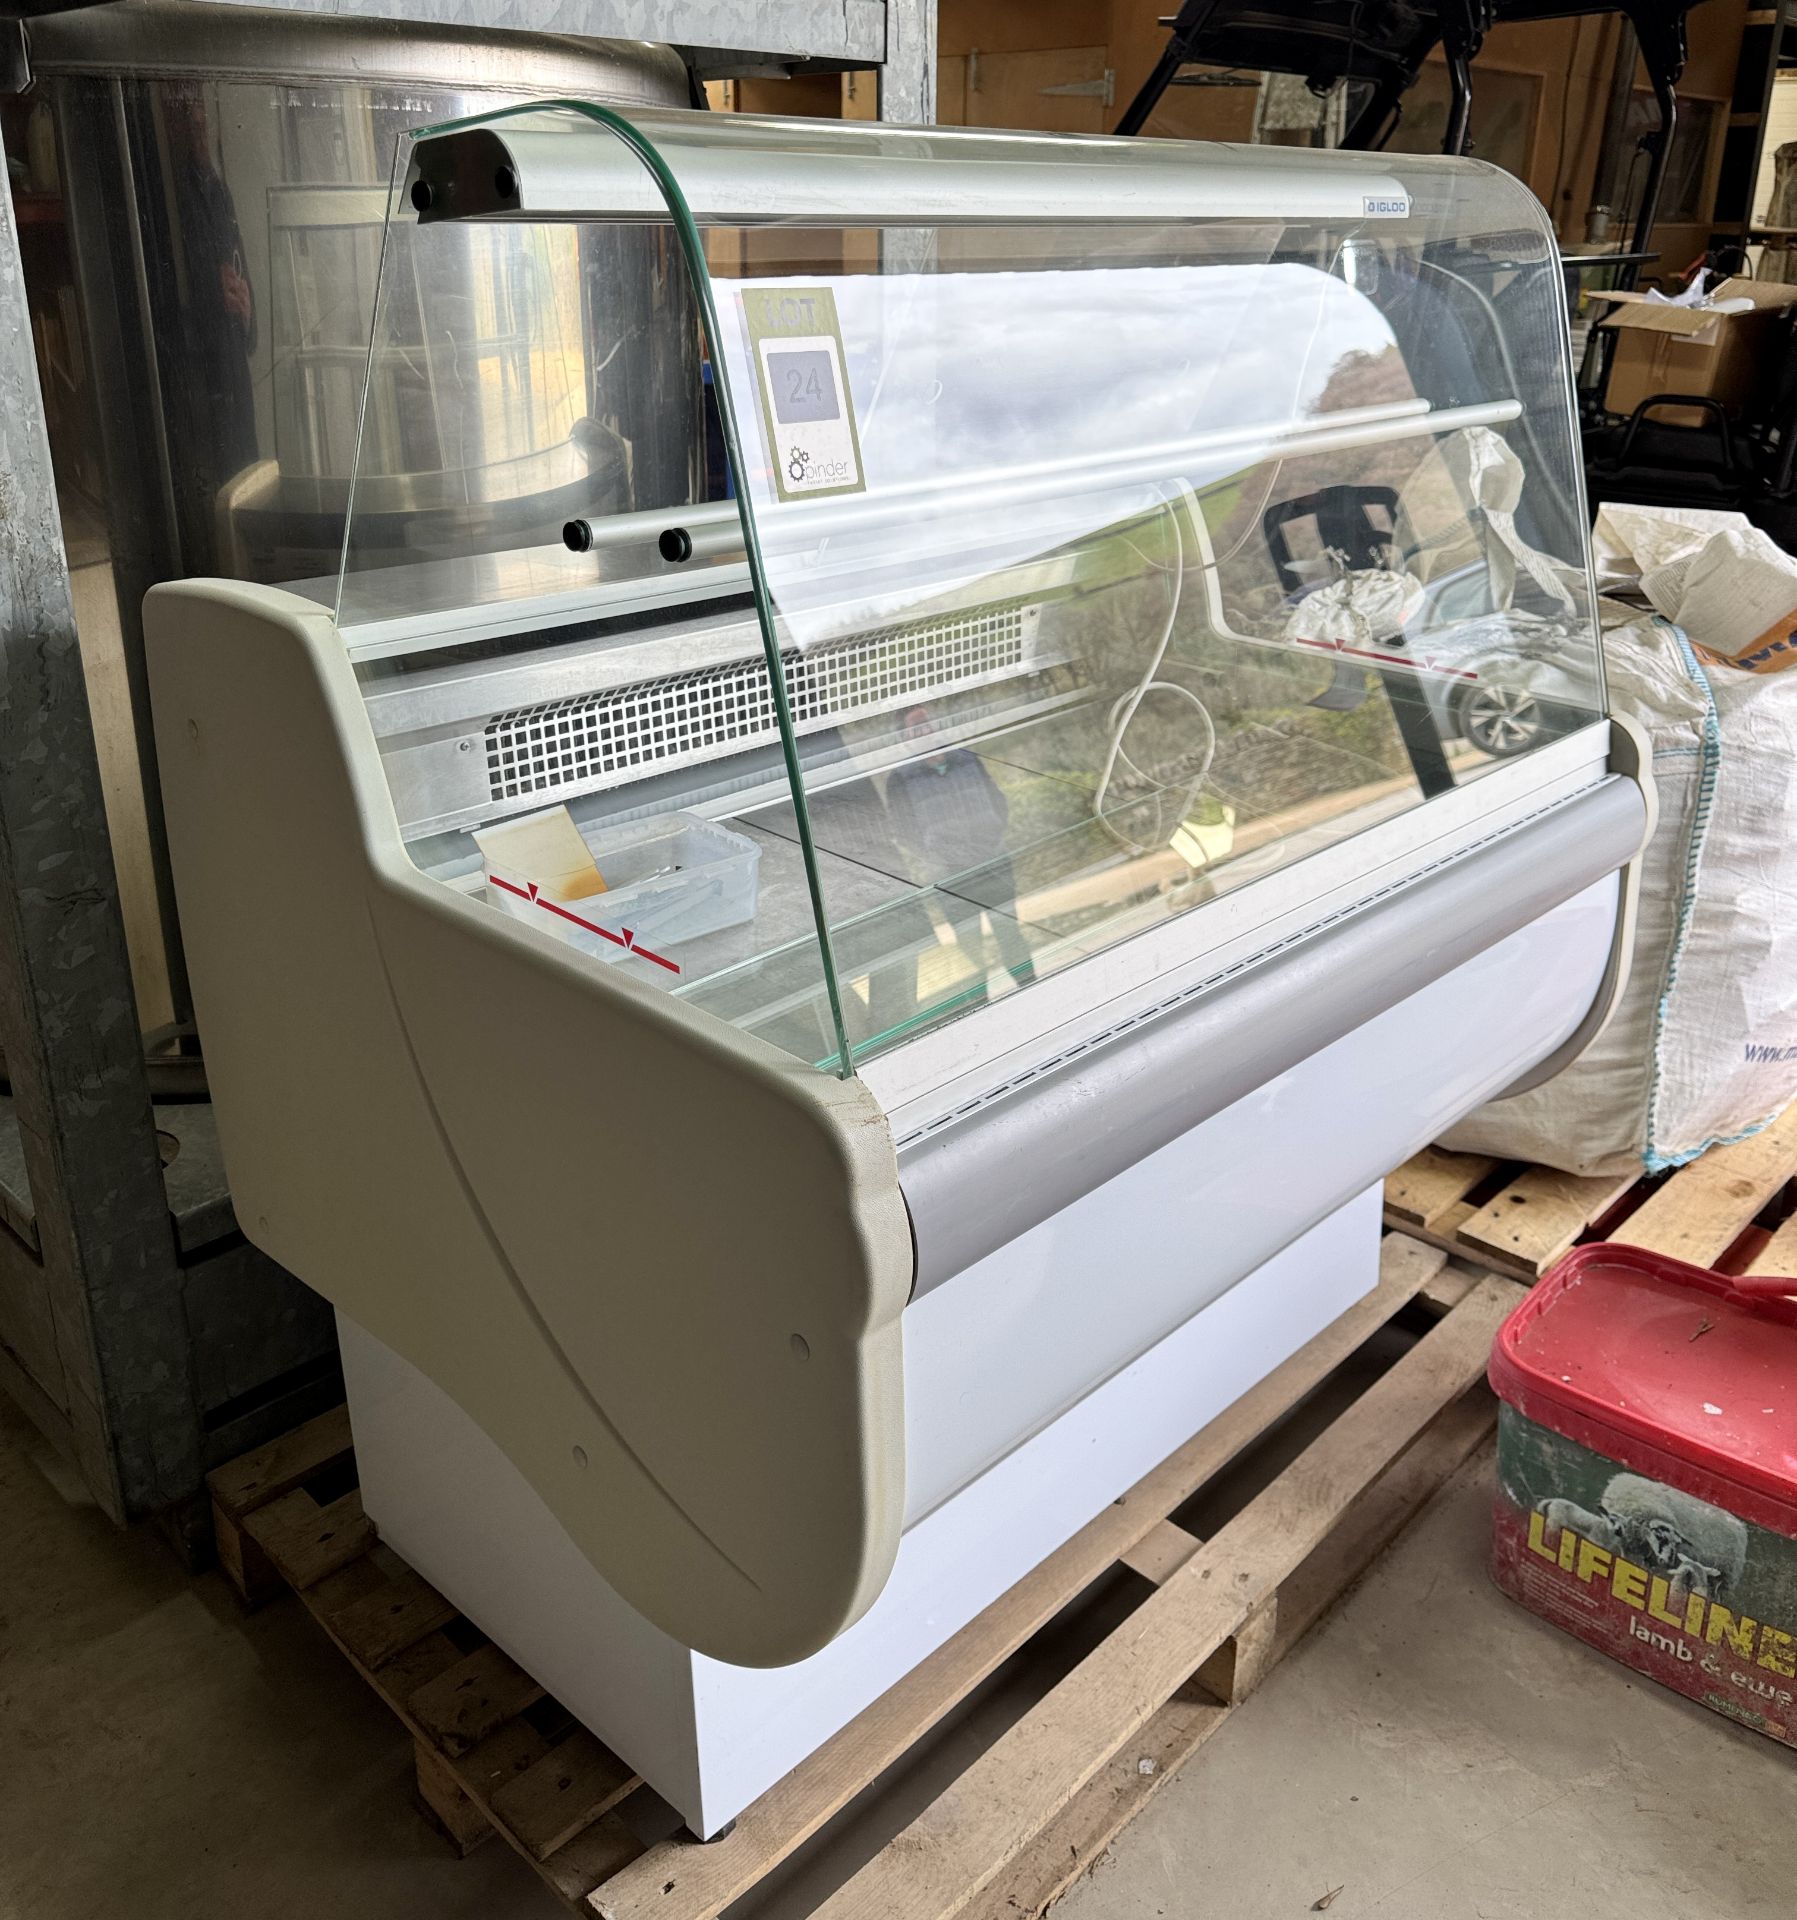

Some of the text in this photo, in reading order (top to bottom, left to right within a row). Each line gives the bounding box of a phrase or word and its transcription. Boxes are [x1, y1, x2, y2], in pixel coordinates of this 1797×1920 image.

[1377, 201, 1406, 212] IGLOO
[764, 297, 817, 328] LOT
[785, 367, 823, 404] 24
[804, 459, 848, 481] pinder
[1527, 1509, 1797, 1679] LIFELINE
[1629, 1615, 1694, 1662] lamb
